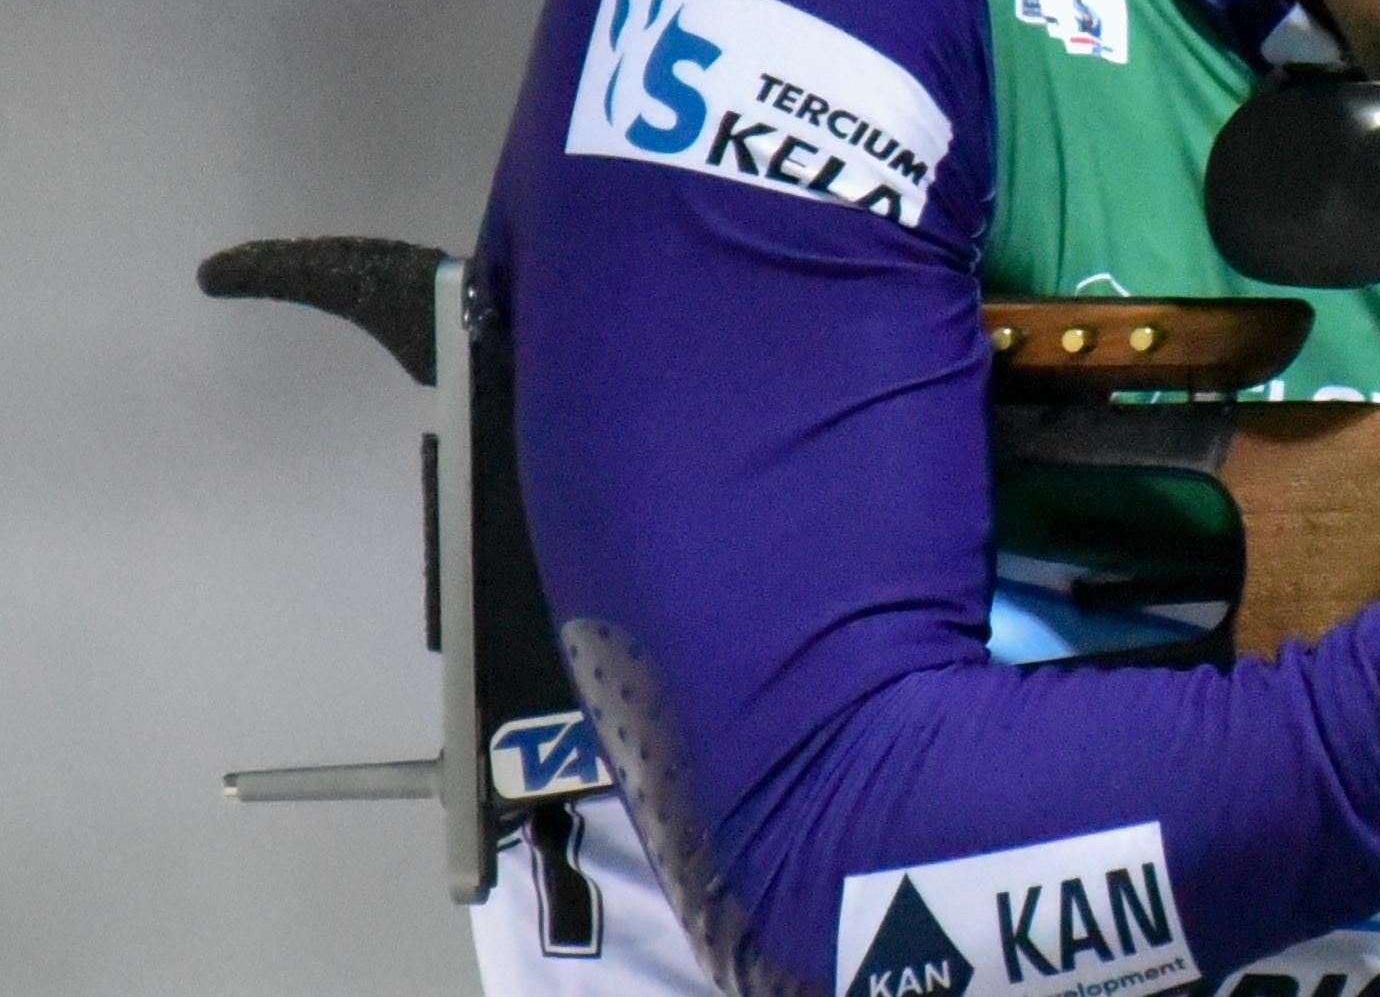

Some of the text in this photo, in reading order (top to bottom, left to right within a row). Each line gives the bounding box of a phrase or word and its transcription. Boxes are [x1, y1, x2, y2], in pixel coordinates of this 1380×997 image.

[755, 73, 928, 186] TERCIUM
[996, 862, 1173, 984] KAN
[868, 960, 951, 997] KAN
[1022, 957, 1186, 997] elopment
